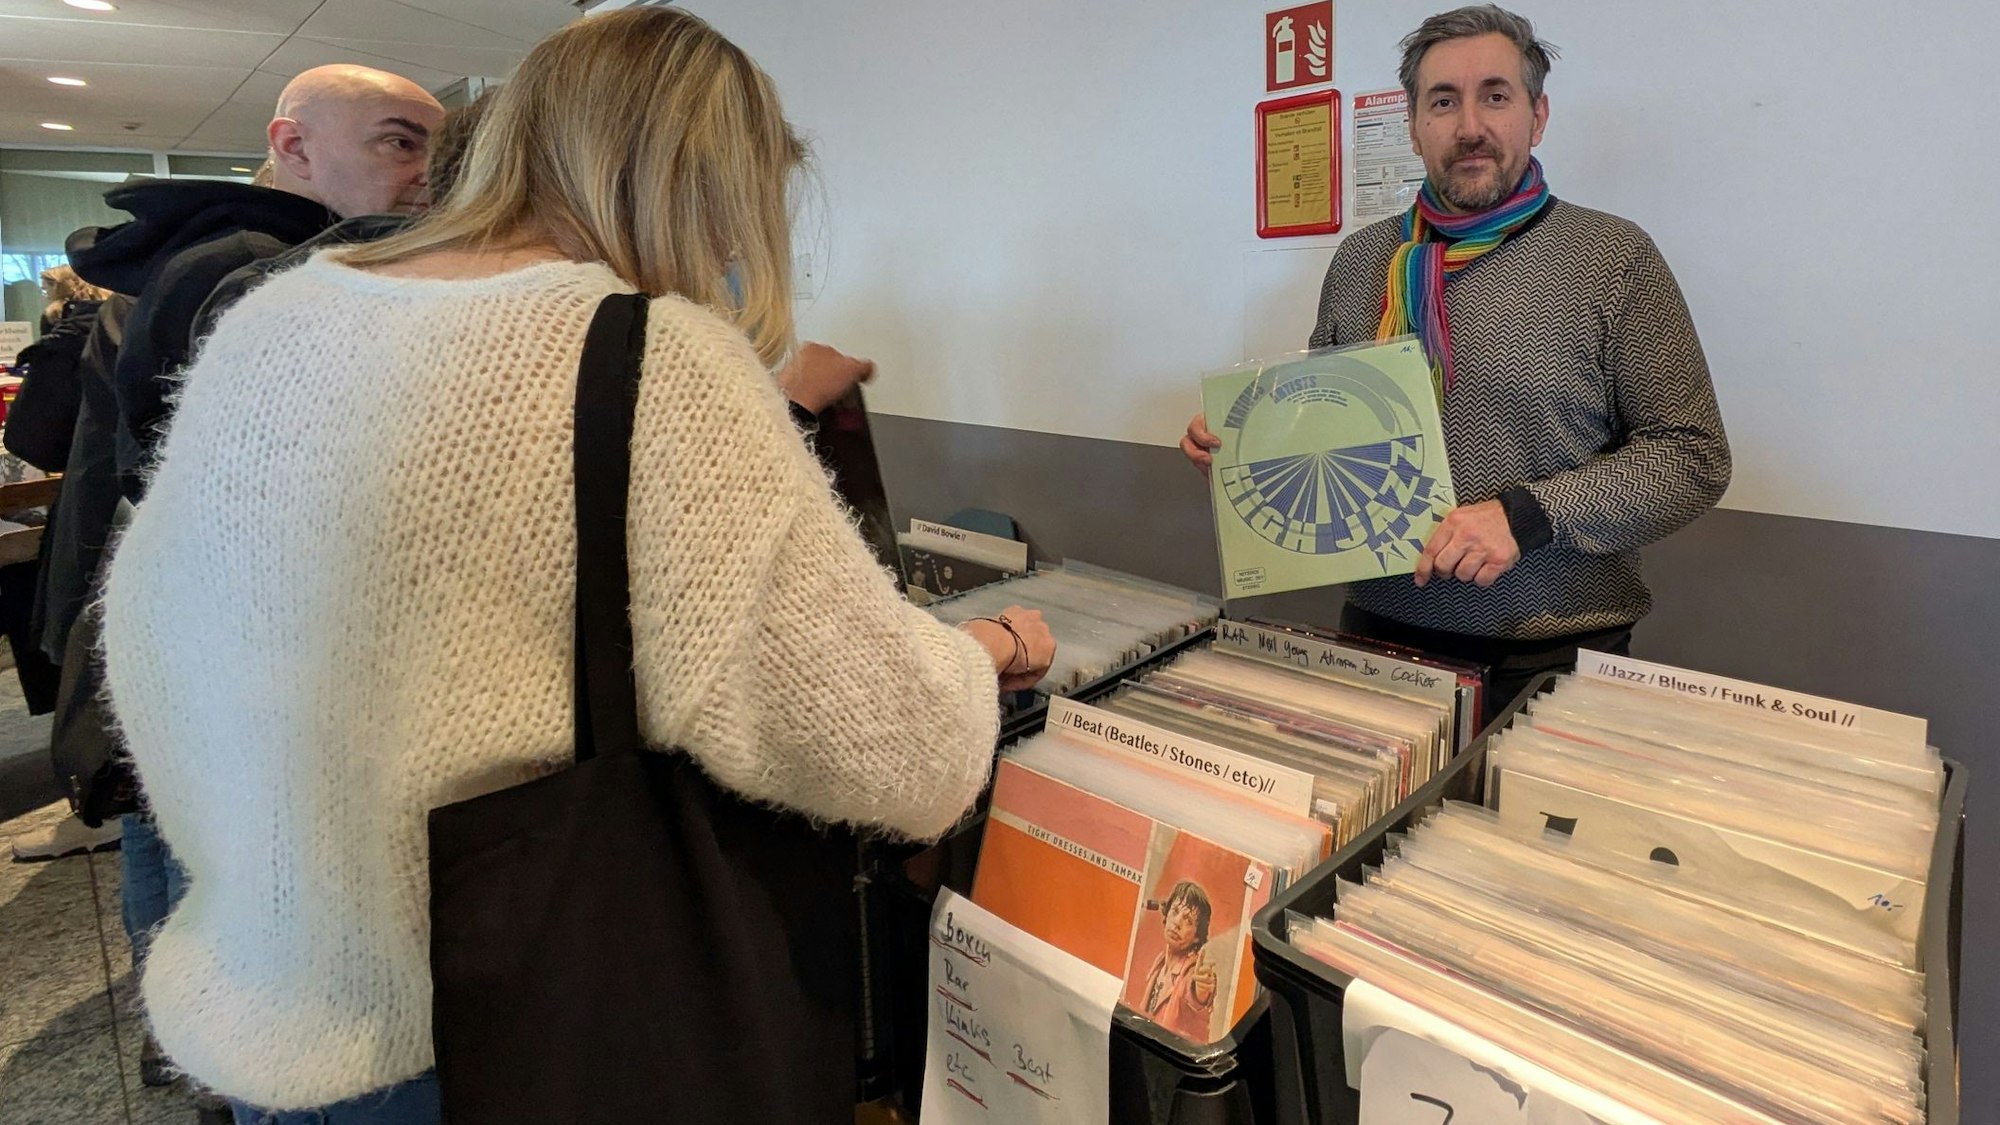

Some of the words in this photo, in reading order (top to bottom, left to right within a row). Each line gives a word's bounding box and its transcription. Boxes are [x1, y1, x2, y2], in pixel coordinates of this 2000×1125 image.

[1364, 93, 1408, 107] Alarmpl
[1334, 434, 1423, 549] JAZZ
[922, 523, 940, 535] David
[941, 528, 961, 541] Bowie
[1658, 674, 1707, 697] Blues
[1721, 687, 1767, 710] Funk
[1770, 698, 1787, 713] &
[1791, 702, 1837, 724] Soul
[1104, 725, 1160, 756] (Beatles
[1169, 746, 1221, 776] Stones
[1027, 824, 1051, 841] TIGHT
[1053, 836, 1088, 859] DRESSES
[1090, 853, 1108, 868] AND
[1110, 862, 1143, 884] TAMPAX
[944, 1000, 992, 1047] Kinks
[1012, 1043, 1055, 1084] Beat
[946, 1053, 976, 1083] etc
